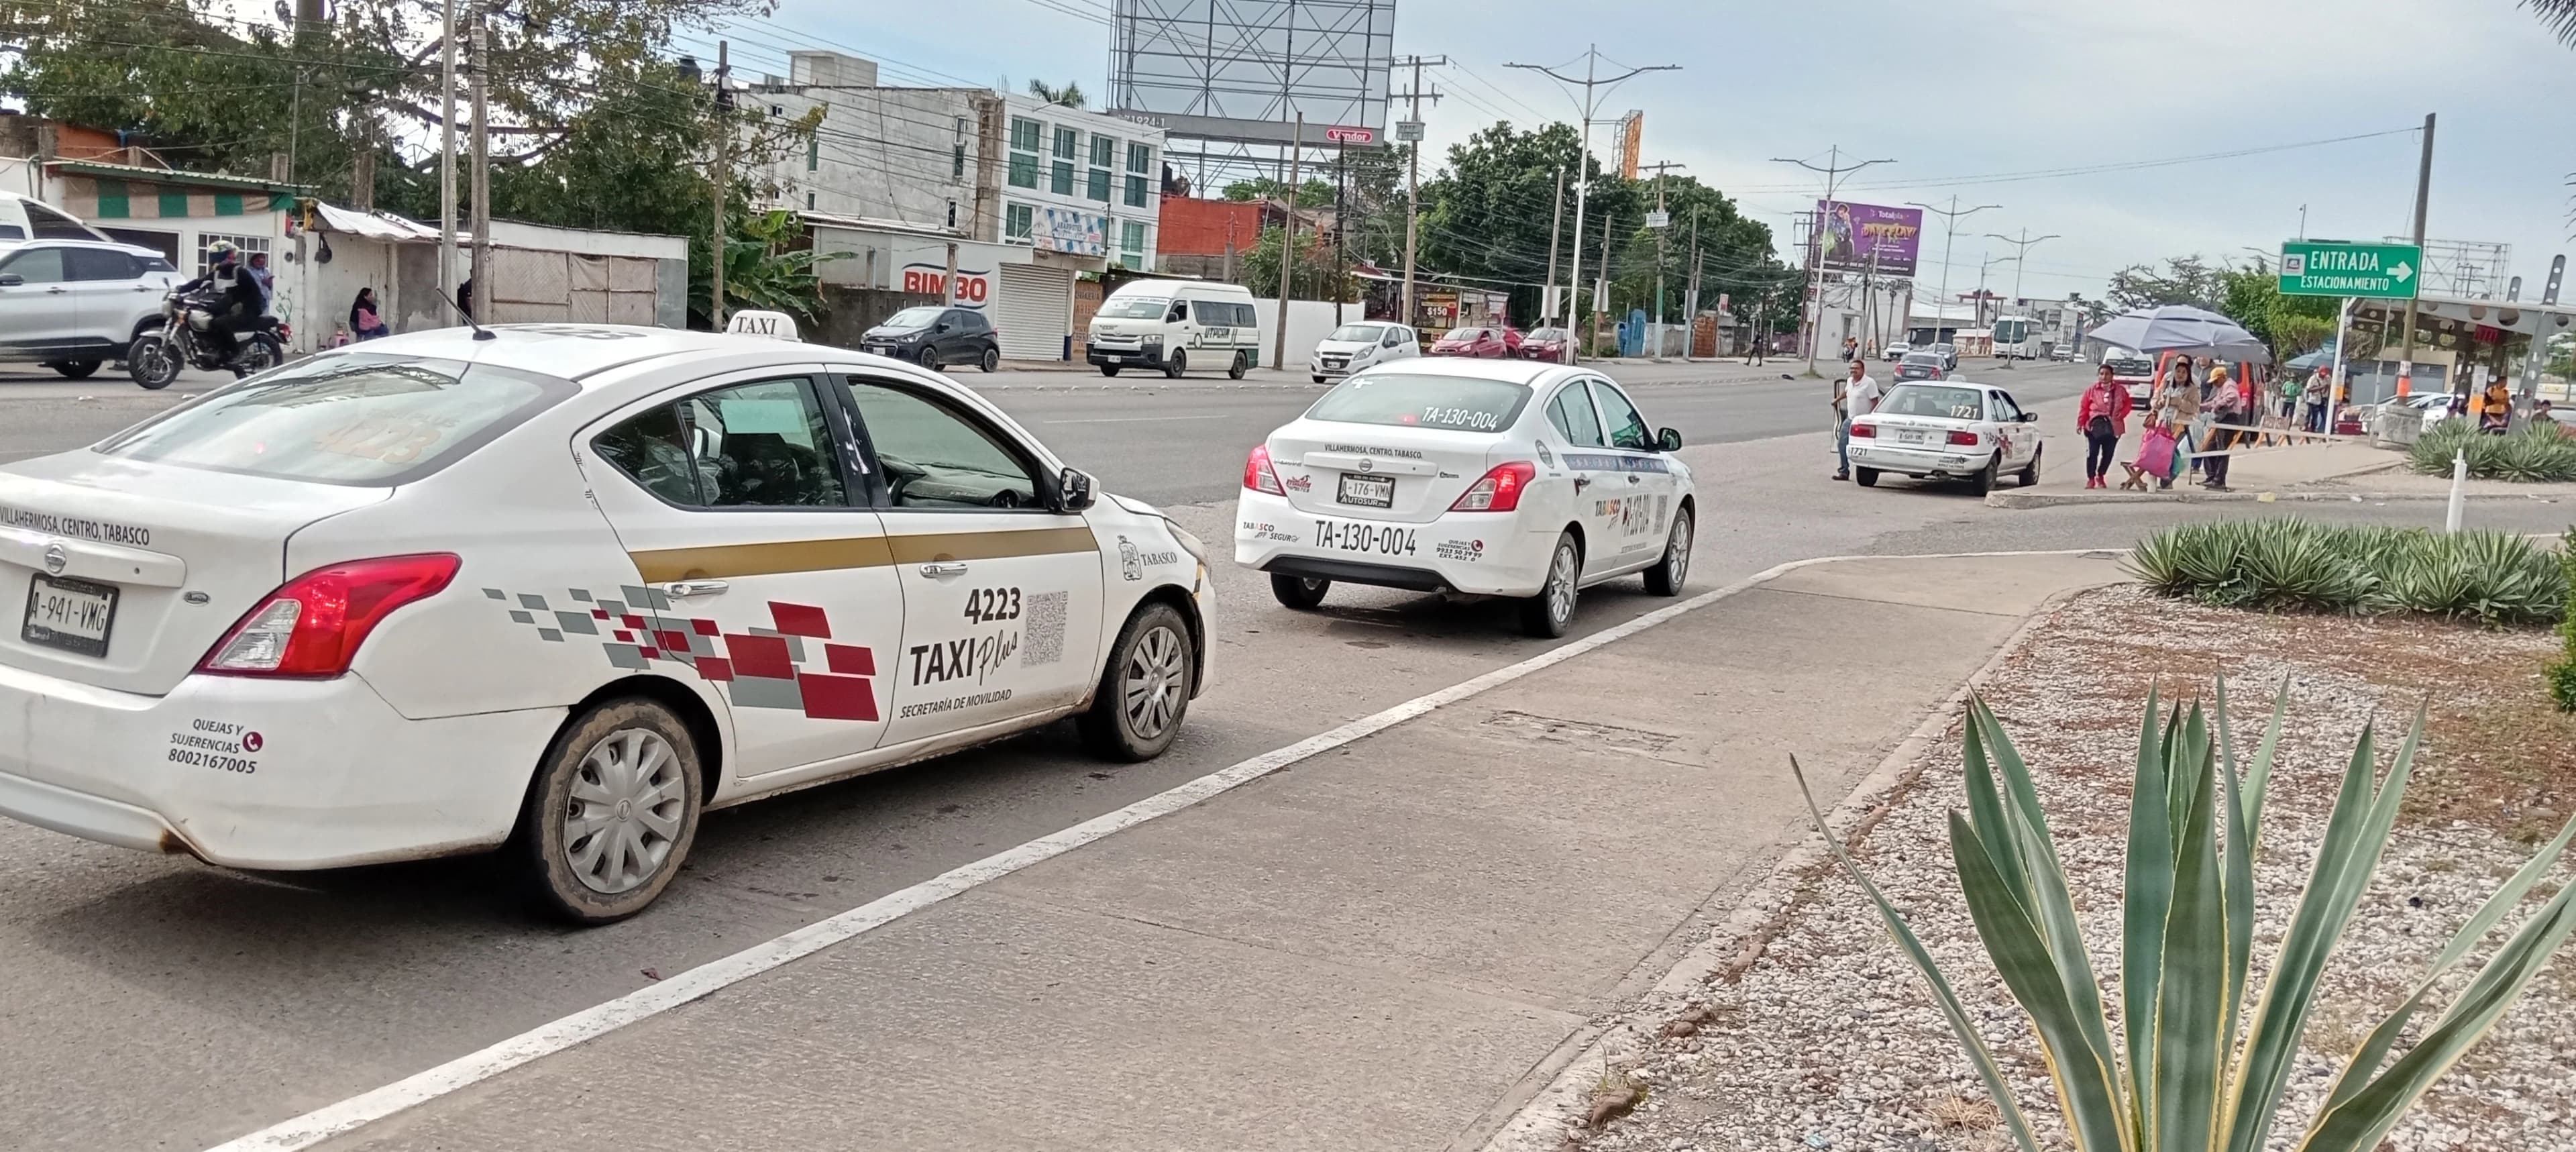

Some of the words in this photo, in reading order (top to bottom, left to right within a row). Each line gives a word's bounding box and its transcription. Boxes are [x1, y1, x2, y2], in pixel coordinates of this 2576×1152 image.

[1332, 131, 1367, 141] Vndor
[2310, 251, 2379, 272] ENTRADA
[2300, 276, 2390, 291] ESTACIONAMIENTO
[1427, 307, 1448, 316] $150
[736, 317, 777, 335] TAXI
[1422, 407, 1498, 431] TA-130-004
[1950, 405, 1978, 419] 1721
[1324, 444, 1368, 454] VILLAHERMOSA,
[1850, 447, 1868, 457] 1721
[1595, 499, 1620, 517] TABASCO
[62, 518, 101, 541] CENTRO,
[103, 523, 150, 545] TABASCO
[1316, 520, 1416, 556] TA-130-004
[1140, 552, 1177, 566] TABASCO
[30, 591, 106, 631] A-941-VMG
[964, 586, 1020, 625] 4223
[910, 638, 975, 686] TAXI
[976, 629, 1017, 686] Plus
[900, 697, 952, 719] SECRETARÍA
[953, 696, 966, 709] DE
[966, 689, 1012, 707] MOVILIDAD
[193, 719, 233, 735] QUEJAS
[236, 725, 244, 735] Y
[170, 733, 240, 753] SUJERENCIAS
[168, 748, 257, 774] 8002167005
